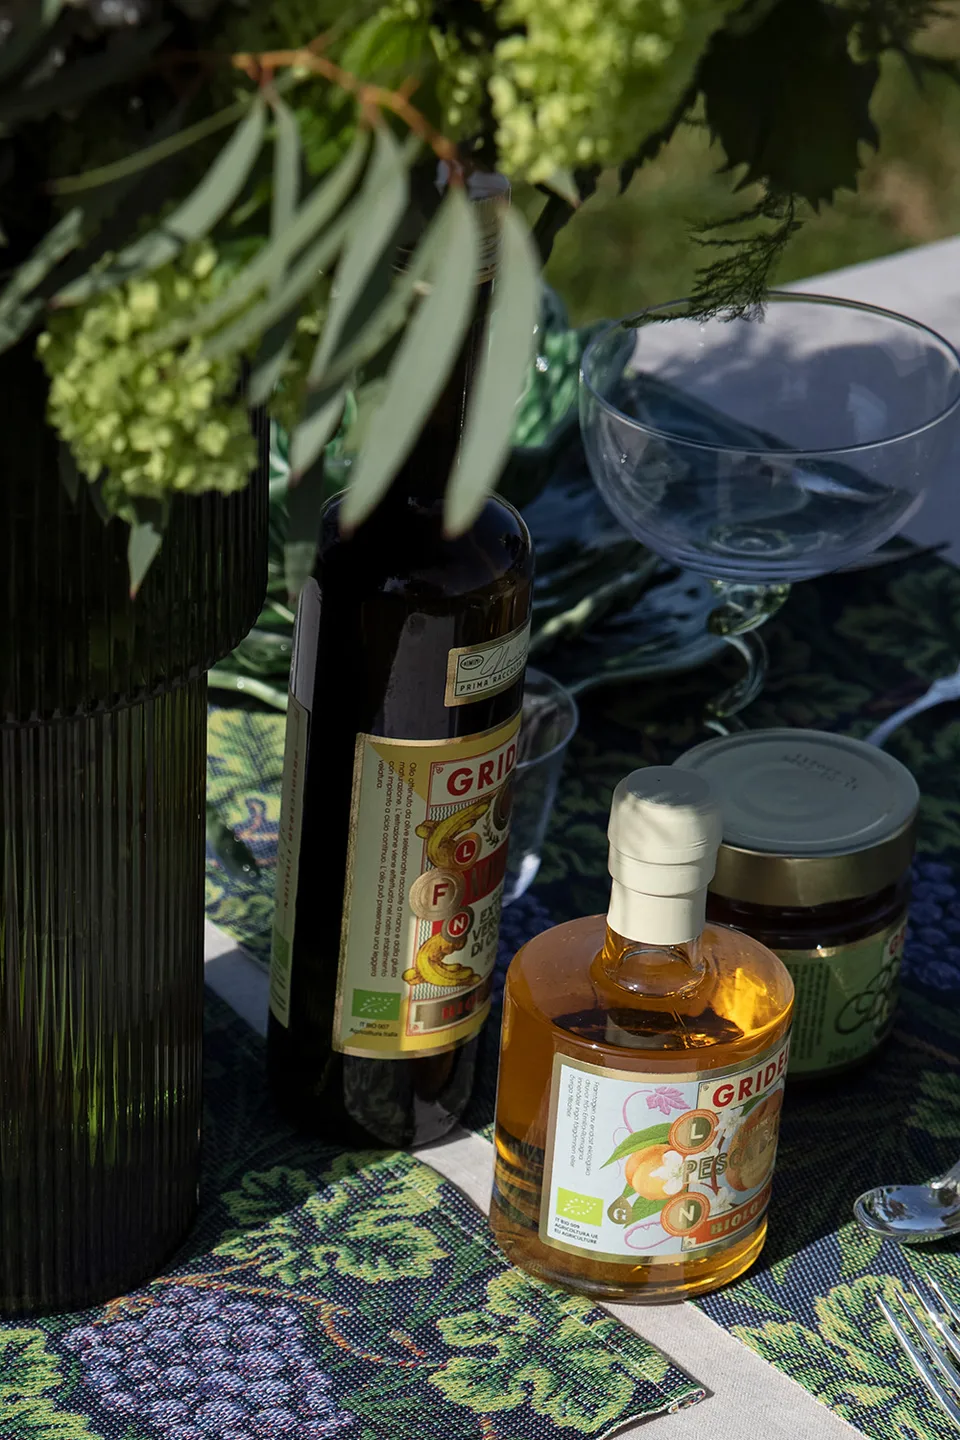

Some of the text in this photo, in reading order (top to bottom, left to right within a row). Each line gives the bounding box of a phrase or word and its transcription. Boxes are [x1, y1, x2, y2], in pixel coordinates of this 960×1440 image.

[460, 679, 488, 691] PRIMA
[408, 762, 418, 777] Olio
[447, 743, 516, 796] GRID
[385, 776, 394, 807] impianto
[395, 761, 406, 807] maturazione.
[406, 778, 415, 807] ottenuto
[383, 814, 391, 831] ciclo
[404, 809, 412, 819] da
[403, 820, 411, 837] olive
[390, 849, 398, 868] viene
[399, 838, 410, 876] selezionate
[462, 845, 471, 858] L
[377, 884, 385, 898] può
[387, 869, 396, 903] effettuata
[397, 876, 405, 905] raccolte
[432, 883, 449, 906] F
[374, 899, 383, 936] presentare
[384, 916, 392, 936] nostro
[394, 912, 402, 933] mano
[453, 916, 465, 932] N
[392, 940, 400, 957] dalla
[390, 957, 398, 978] giusta
[690, 1123, 704, 1140] L
[678, 1204, 696, 1222] N
